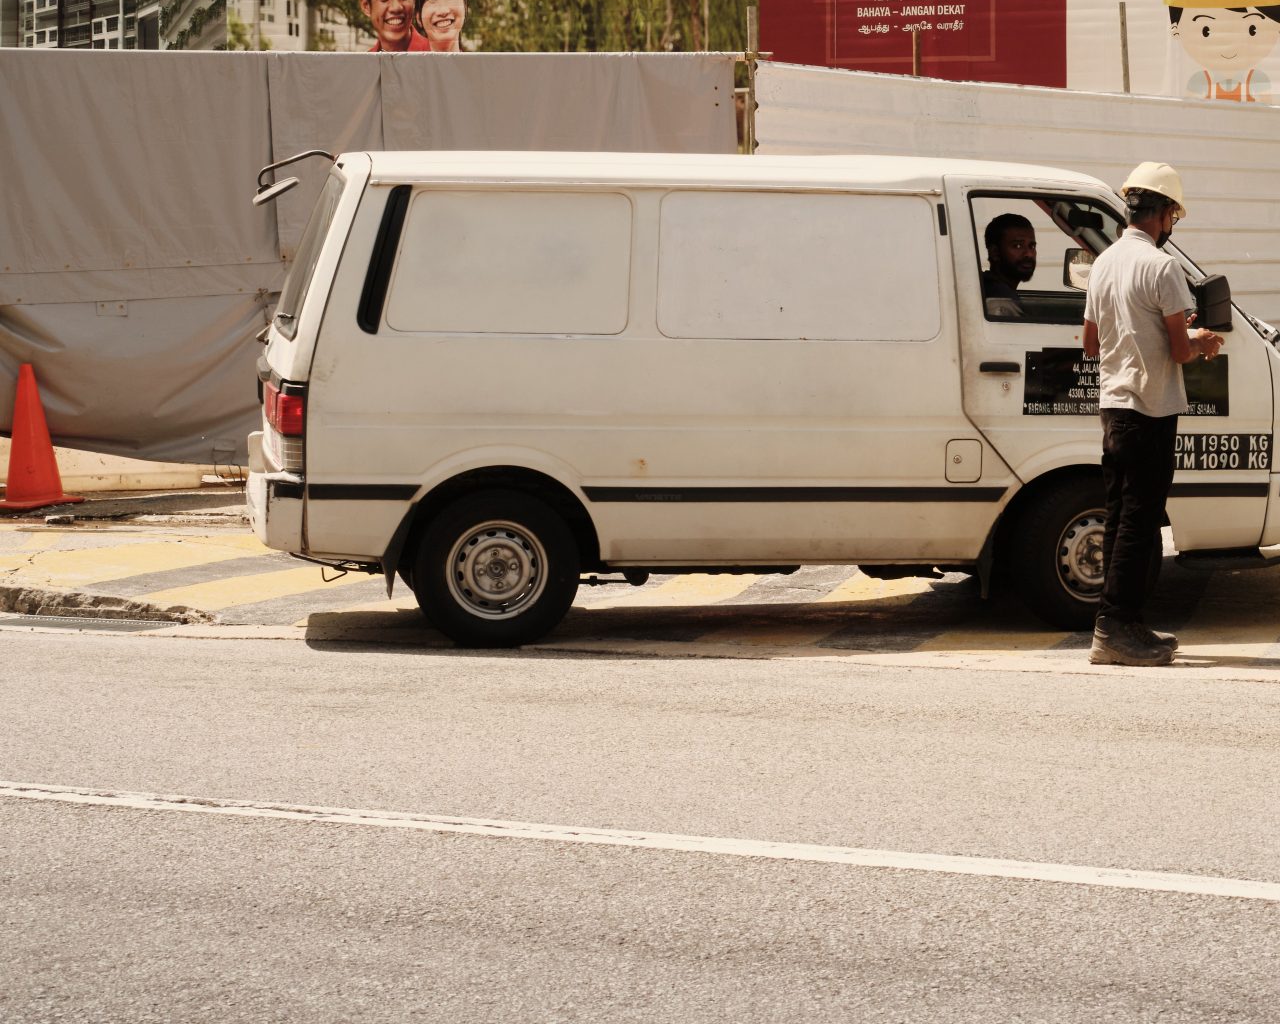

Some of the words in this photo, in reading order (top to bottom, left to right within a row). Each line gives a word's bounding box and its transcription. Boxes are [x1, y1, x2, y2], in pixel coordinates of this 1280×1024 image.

[857, 7, 891, 18] BAHAYA
[900, 6, 935, 17] JANGAN
[937, 4, 966, 15] DEKAT
[1077, 375, 1095, 387] JALIL,
[1068, 388, 1086, 400] 43300,
[1201, 435, 1239, 451] 1950
[1249, 435, 1269, 451] KG
[1199, 452, 1239, 469] 1090
[1247, 452, 1269, 469] KG
